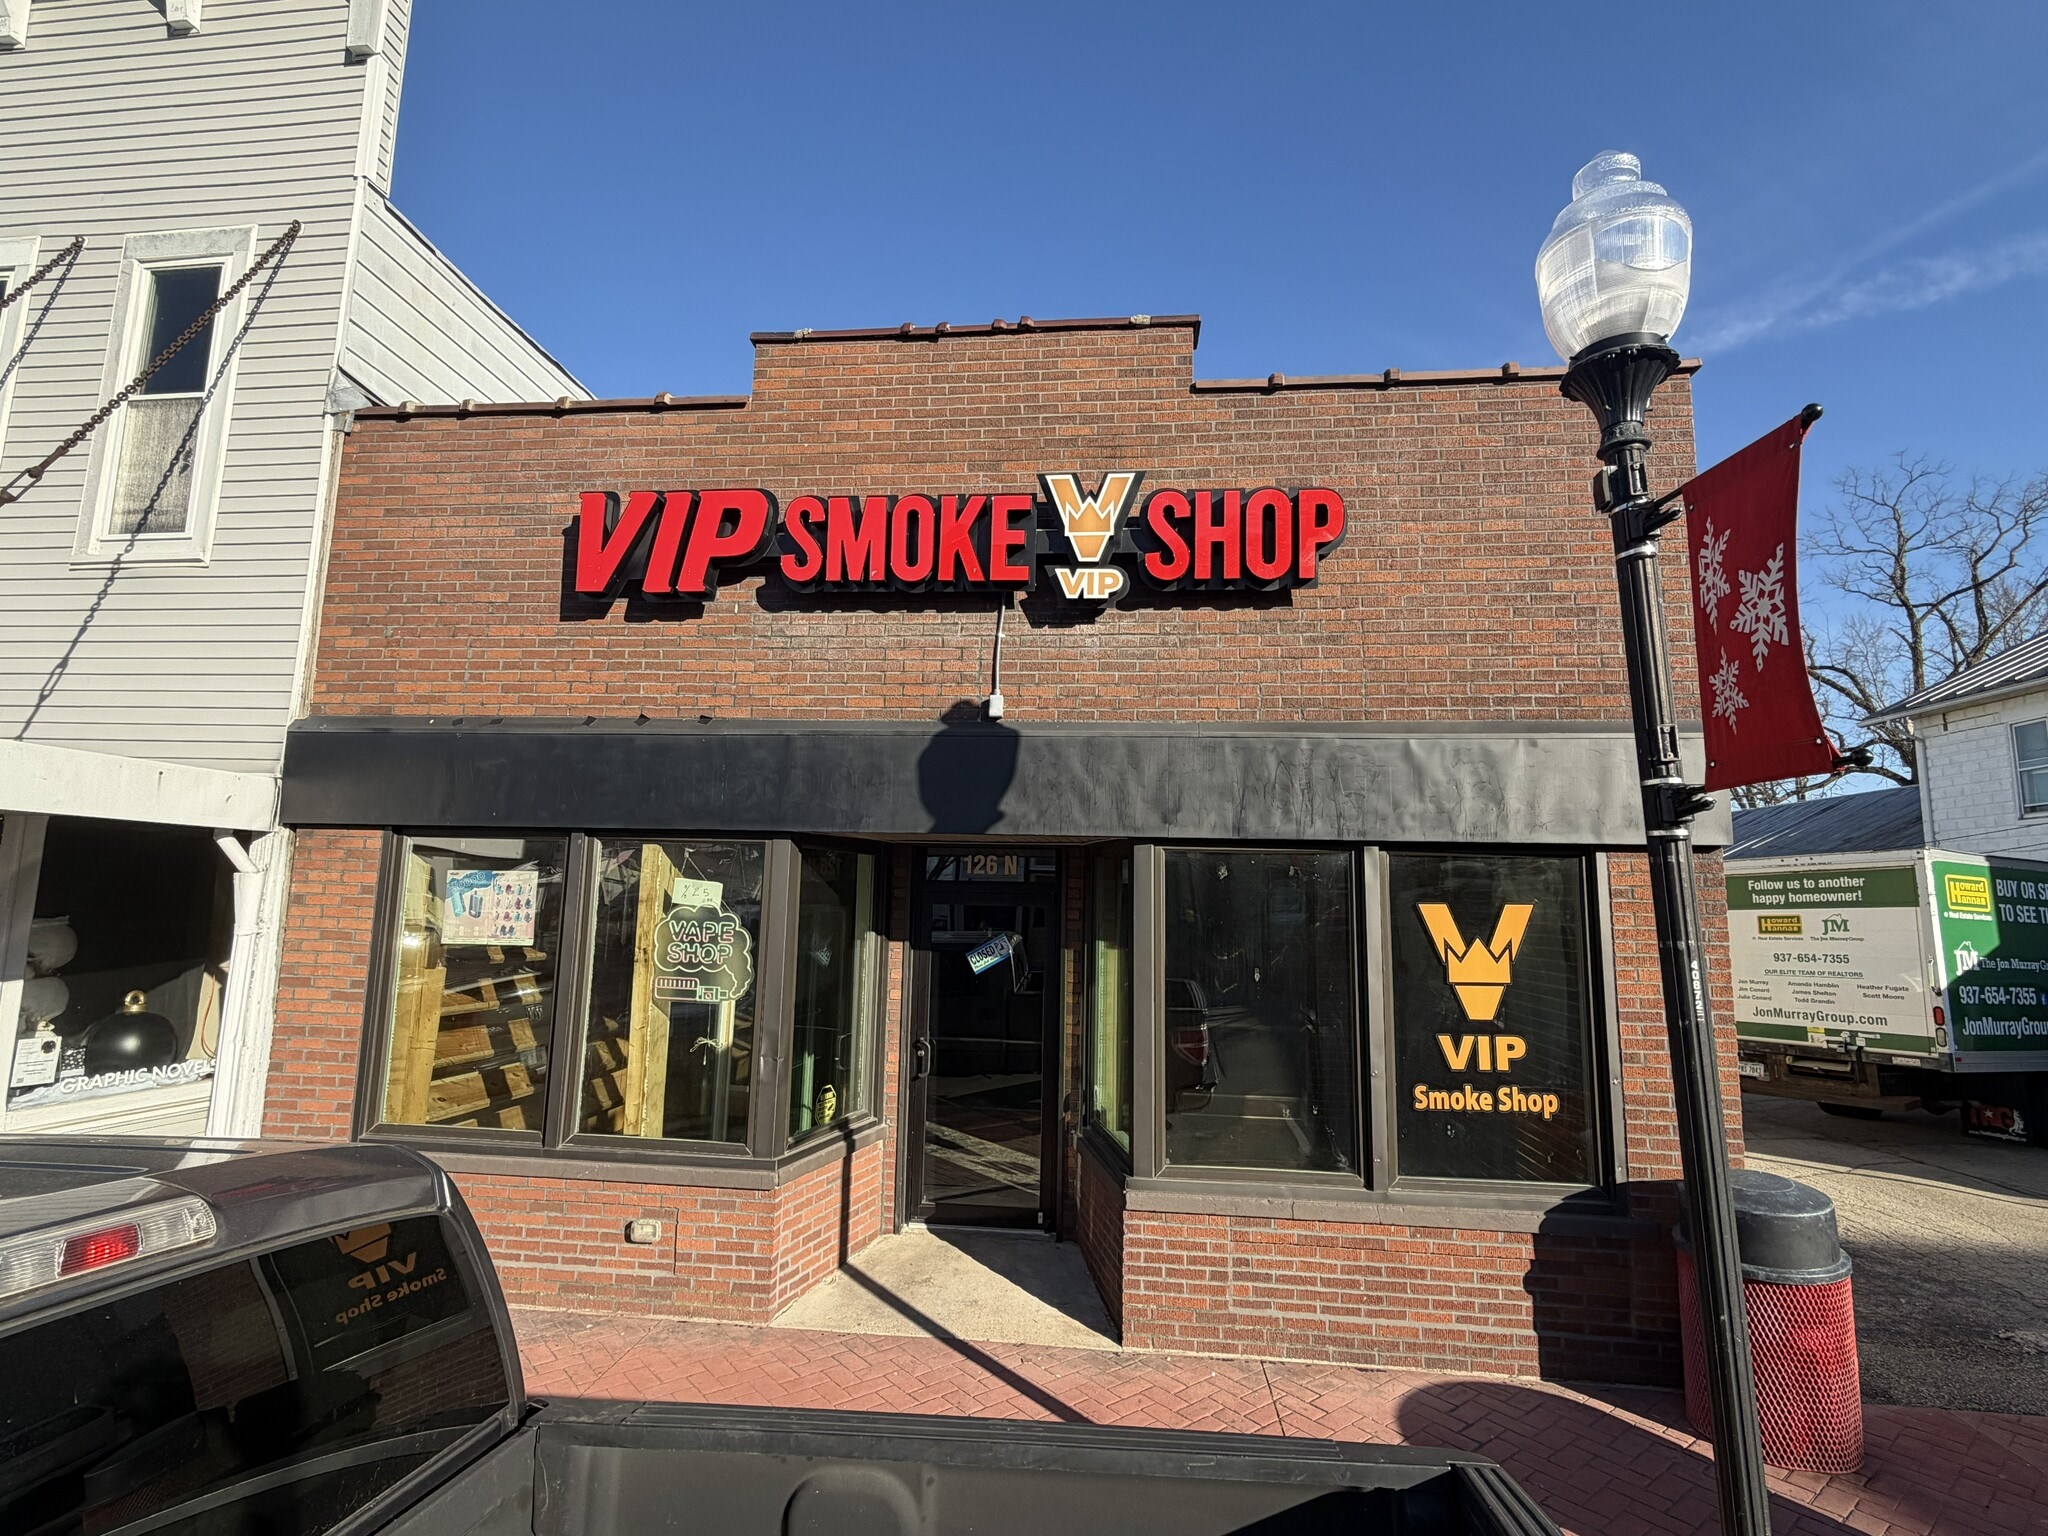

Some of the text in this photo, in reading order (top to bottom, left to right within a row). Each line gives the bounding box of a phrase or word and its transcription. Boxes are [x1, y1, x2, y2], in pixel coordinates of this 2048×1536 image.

[575, 488, 1347, 594] VIP SMOKE SHOP
[1055, 567, 1124, 599] VIP
[964, 855, 1018, 875] 126 N
[1748, 876, 1865, 891] Follow us to another
[1995, 878, 2018, 898] BUY
[2020, 881, 2037, 900] OR
[1752, 890, 1863, 905] happy homeowner!
[1998, 903, 2014, 922] TO
[2016, 905, 2038, 924] SEE
[669, 920, 735, 943] VAPE
[1822, 919, 1850, 936] JM
[667, 942, 733, 965] SHOP
[969, 944, 996, 965] CLOSED
[1773, 952, 1850, 964] 937-654-7355
[1953, 949, 1980, 977] JM
[1827, 970, 1863, 978] REALTORS
[1857, 983, 1883, 991] Heather
[1959, 985, 2037, 1006] 937-654-7355
[1753, 1006, 1888, 1026] JonMurrayGroup.com
[1437, 1034, 1527, 1072] VIP
[60, 1067, 148, 1094] GRAPHIC
[1414, 1085, 1559, 1119] Smoke Shop
